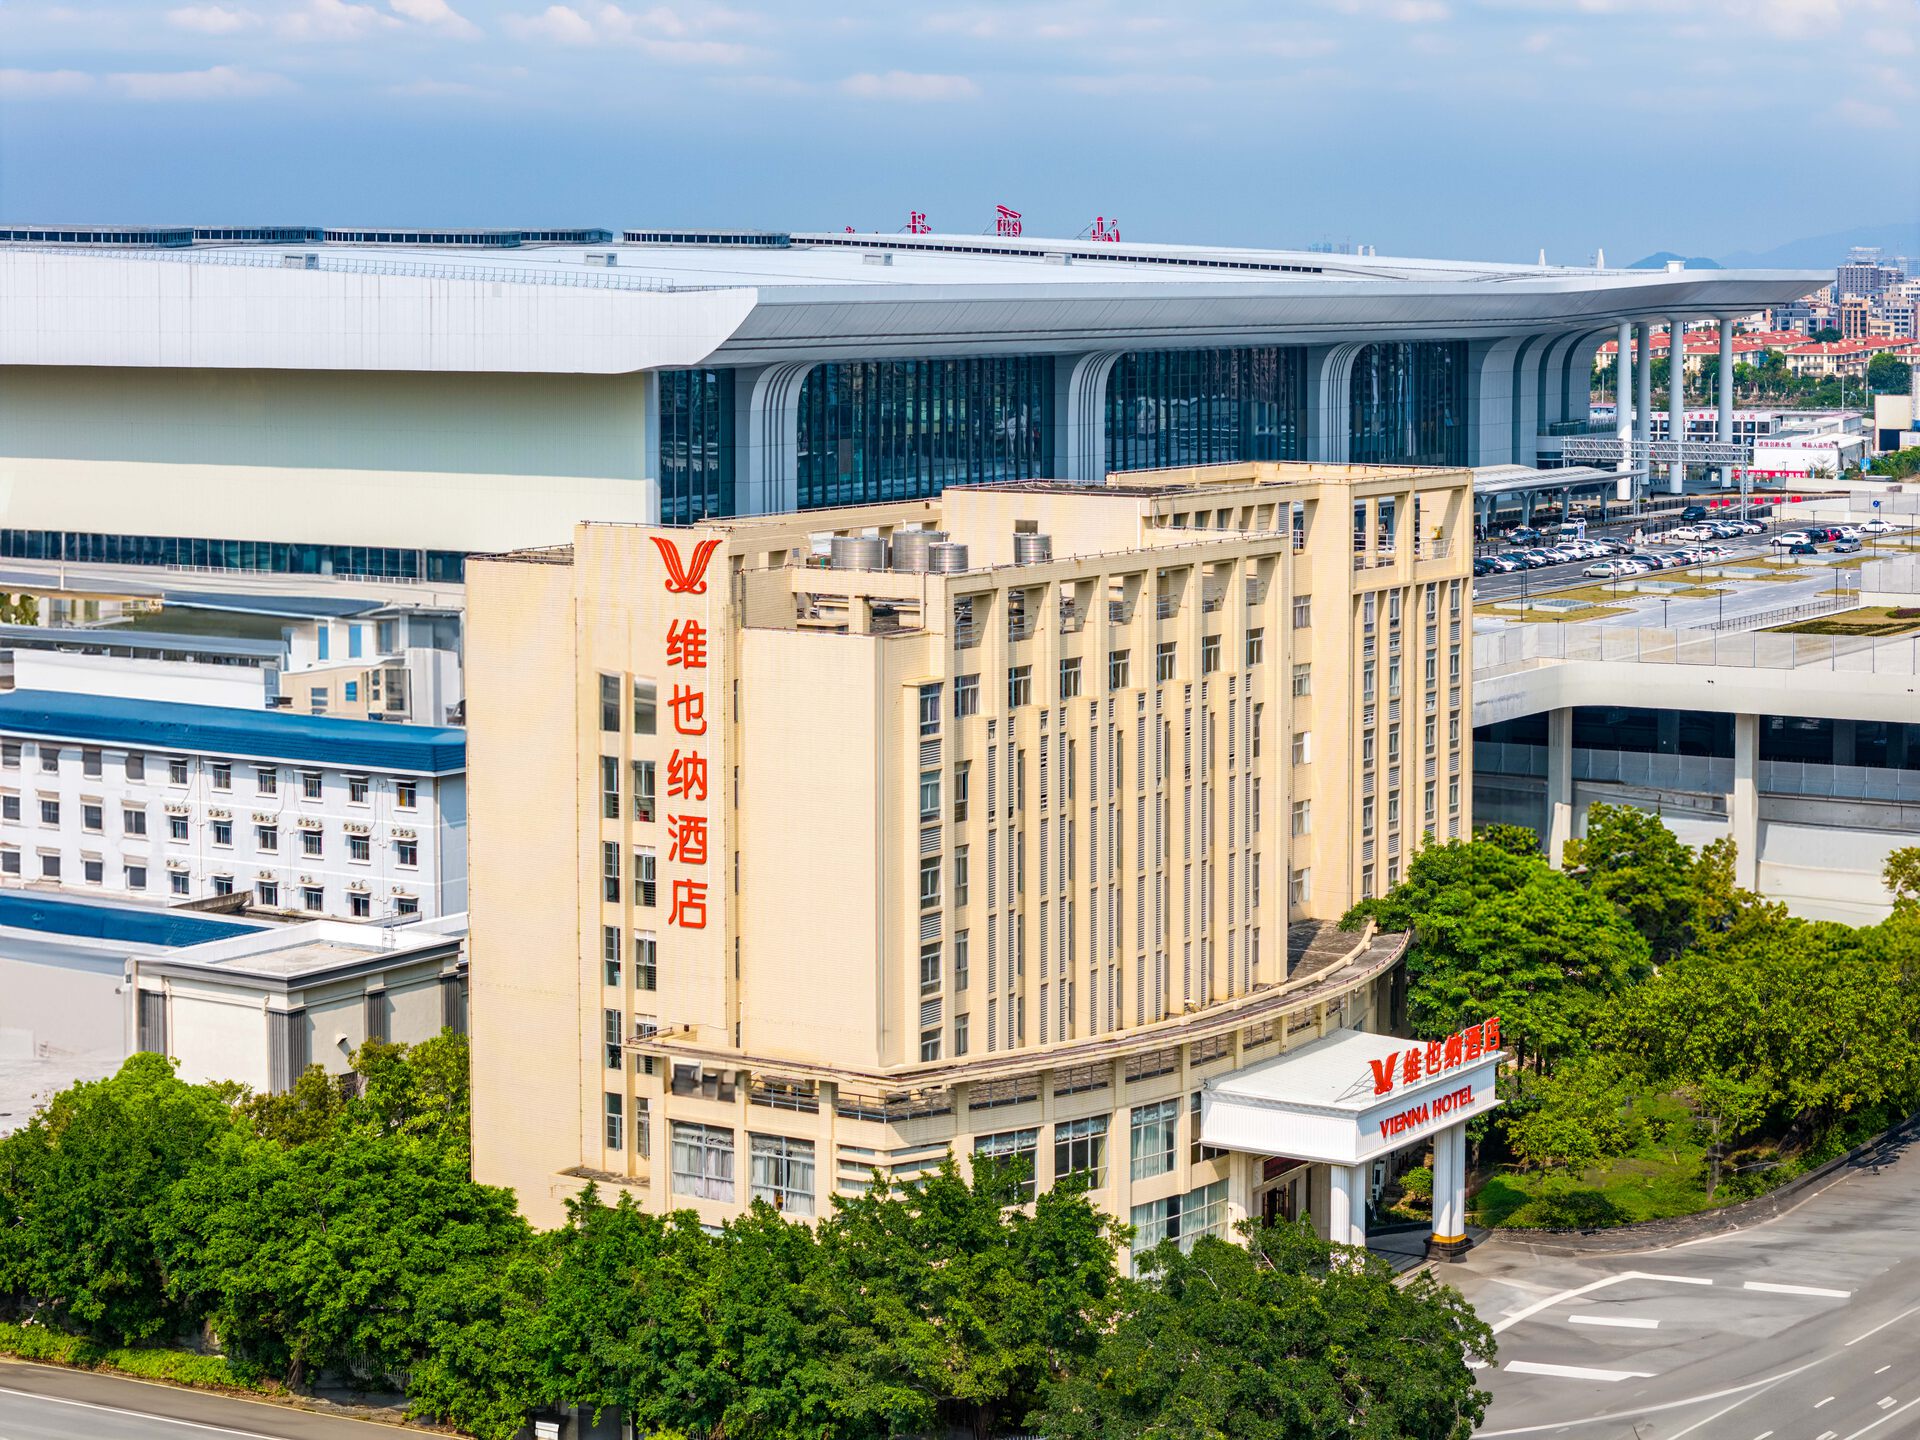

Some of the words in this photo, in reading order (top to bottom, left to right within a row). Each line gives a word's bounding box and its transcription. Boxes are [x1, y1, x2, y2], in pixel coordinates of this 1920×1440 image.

[666, 618, 708, 930] 维也纳酒店
[1403, 1017, 1500, 1084] 维也纳酒店
[1379, 1102, 1429, 1138] VIENNA
[1432, 1085, 1475, 1118] HOTEL
